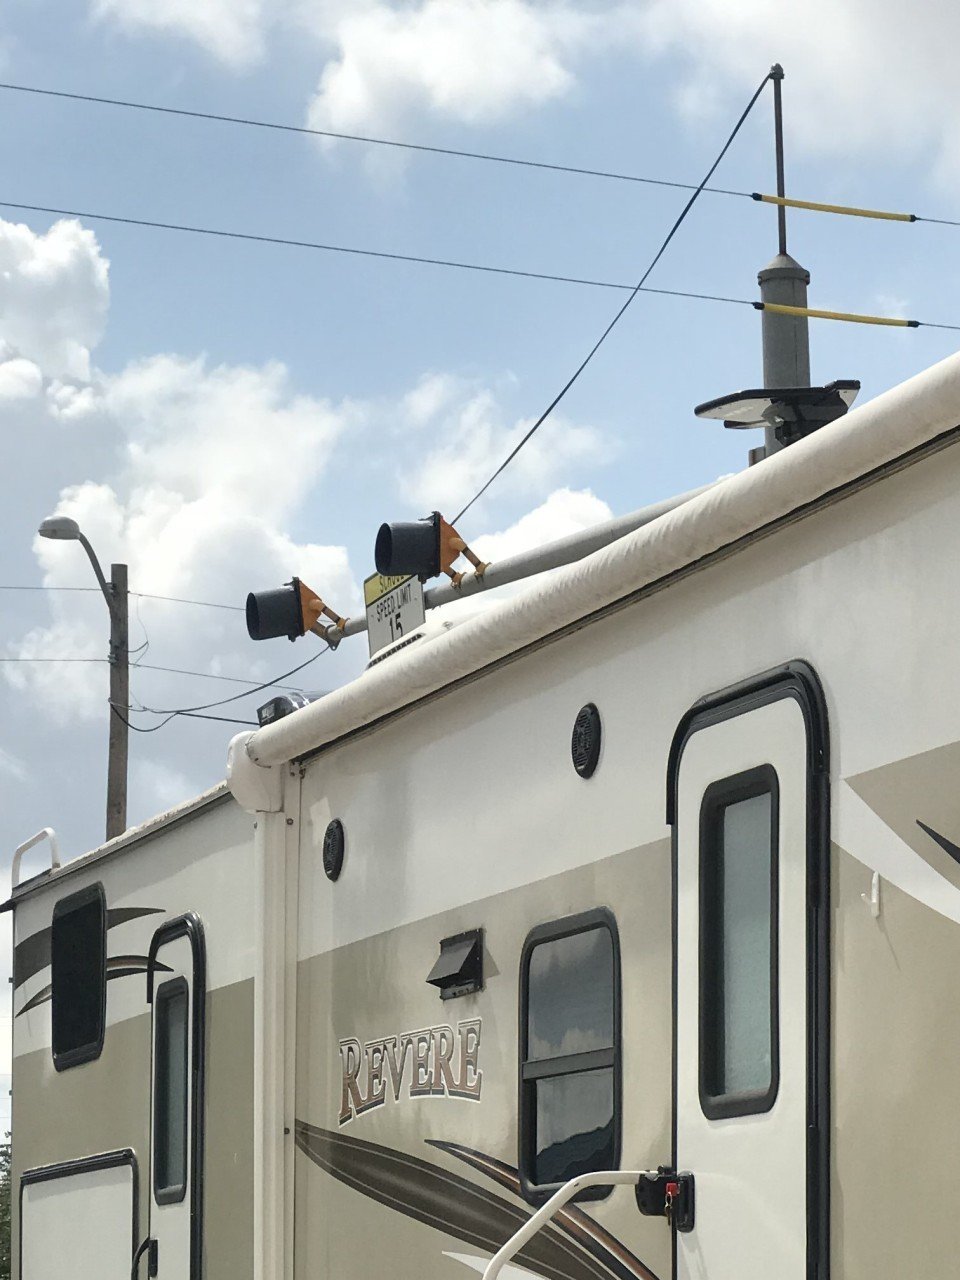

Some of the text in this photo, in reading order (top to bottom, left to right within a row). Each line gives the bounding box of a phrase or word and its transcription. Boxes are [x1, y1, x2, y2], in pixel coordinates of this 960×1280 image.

[376, 583, 412, 623] SPEED LIMIT
[389, 612, 404, 642] 15
[338, 1017, 483, 1128] REVERE
